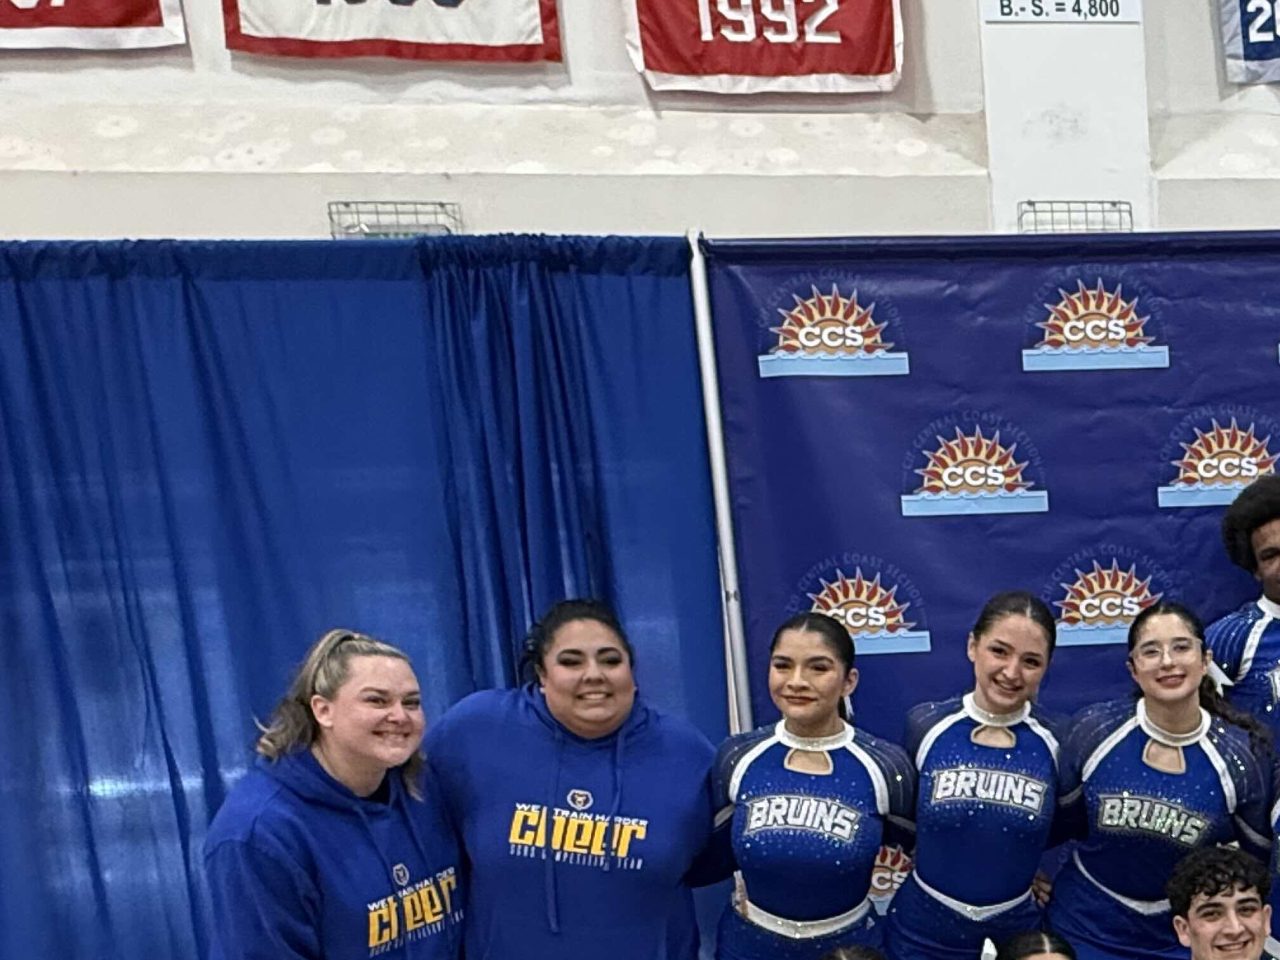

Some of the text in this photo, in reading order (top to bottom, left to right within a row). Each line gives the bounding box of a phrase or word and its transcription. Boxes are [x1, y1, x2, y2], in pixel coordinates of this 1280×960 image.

[1071, 0, 1119, 20] 4,800
[799, 325, 864, 348] CCS
[1063, 320, 1126, 341] CCS
[942, 465, 1005, 488] CCS
[1197, 456, 1259, 478] CCS
[1079, 597, 1142, 618] CCS
[935, 771, 1044, 810] BRUINS
[750, 798, 857, 840] BRUINS
[1103, 799, 1204, 843] BRUINS
